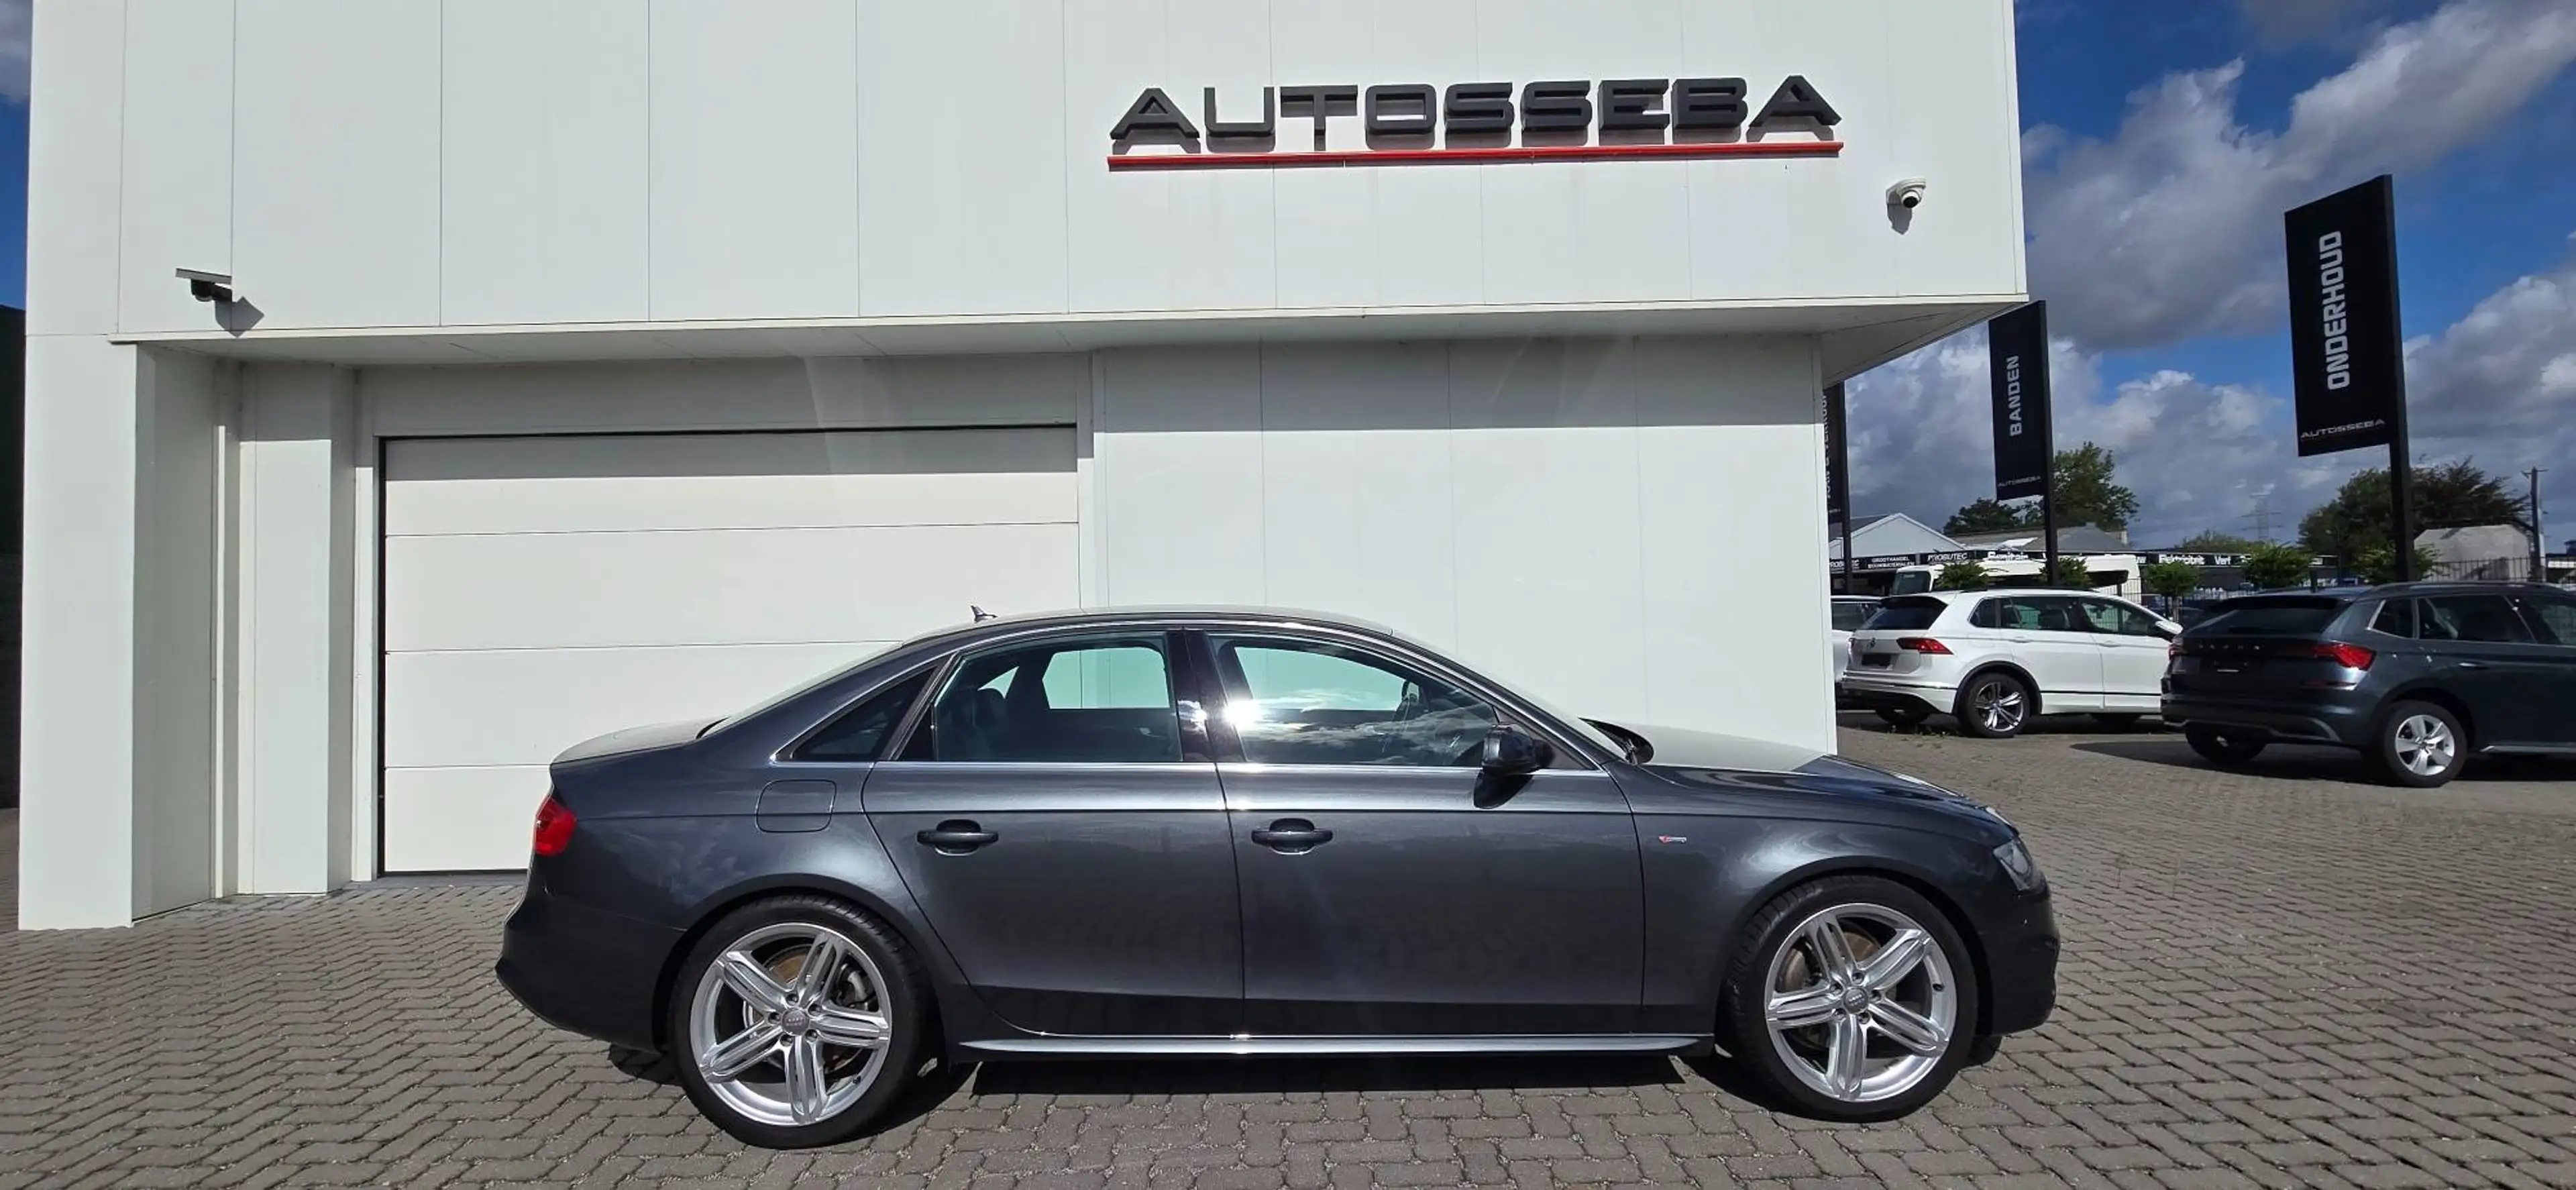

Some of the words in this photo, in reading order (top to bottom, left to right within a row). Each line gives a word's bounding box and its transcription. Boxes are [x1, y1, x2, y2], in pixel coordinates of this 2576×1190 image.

[1108, 74, 1843, 140] AUTOSSEBA
[2319, 230, 2351, 391] ONDERHOUD
[2006, 355, 2023, 437] BANDEN
[2300, 418, 2385, 439] AUTOSSEBA
